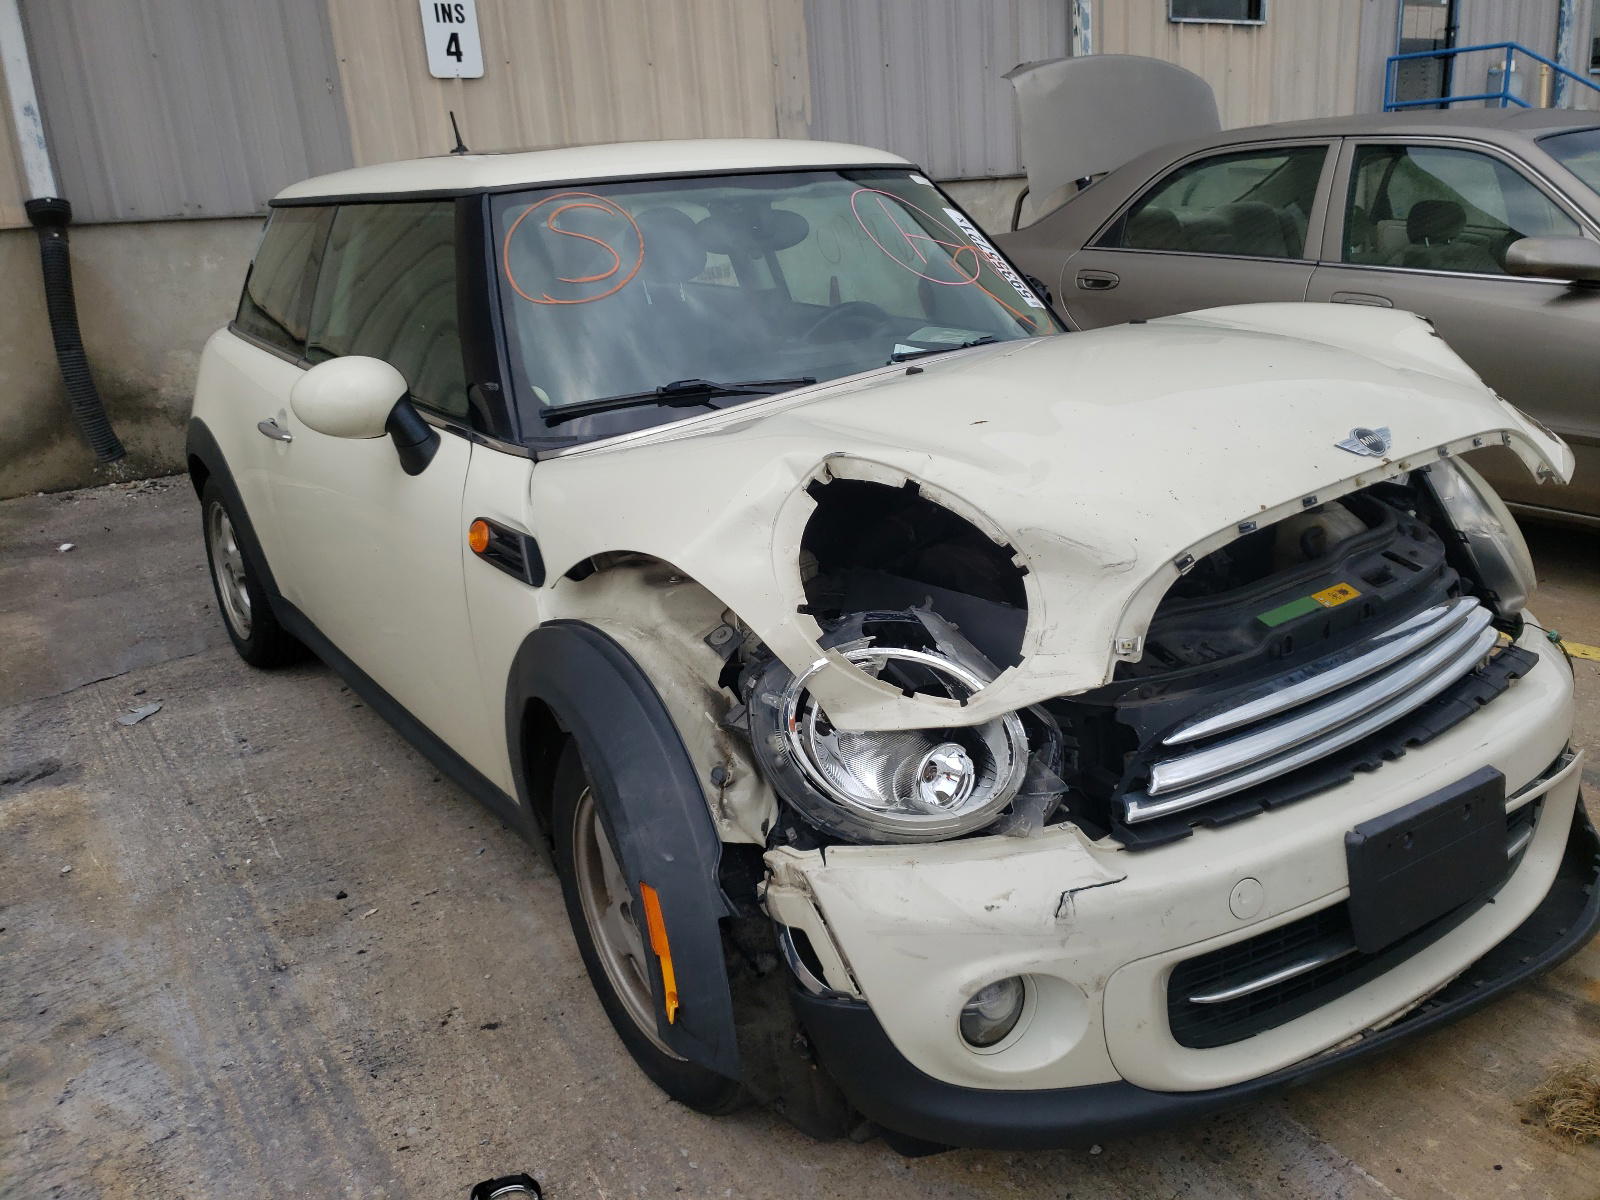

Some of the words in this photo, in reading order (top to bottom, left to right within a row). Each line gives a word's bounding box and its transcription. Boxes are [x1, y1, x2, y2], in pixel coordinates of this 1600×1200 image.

[433, 3, 466, 24] INS
[446, 32, 463, 63] 4
[548, 203, 621, 283] S
[1359, 434, 1382, 446] MINI
